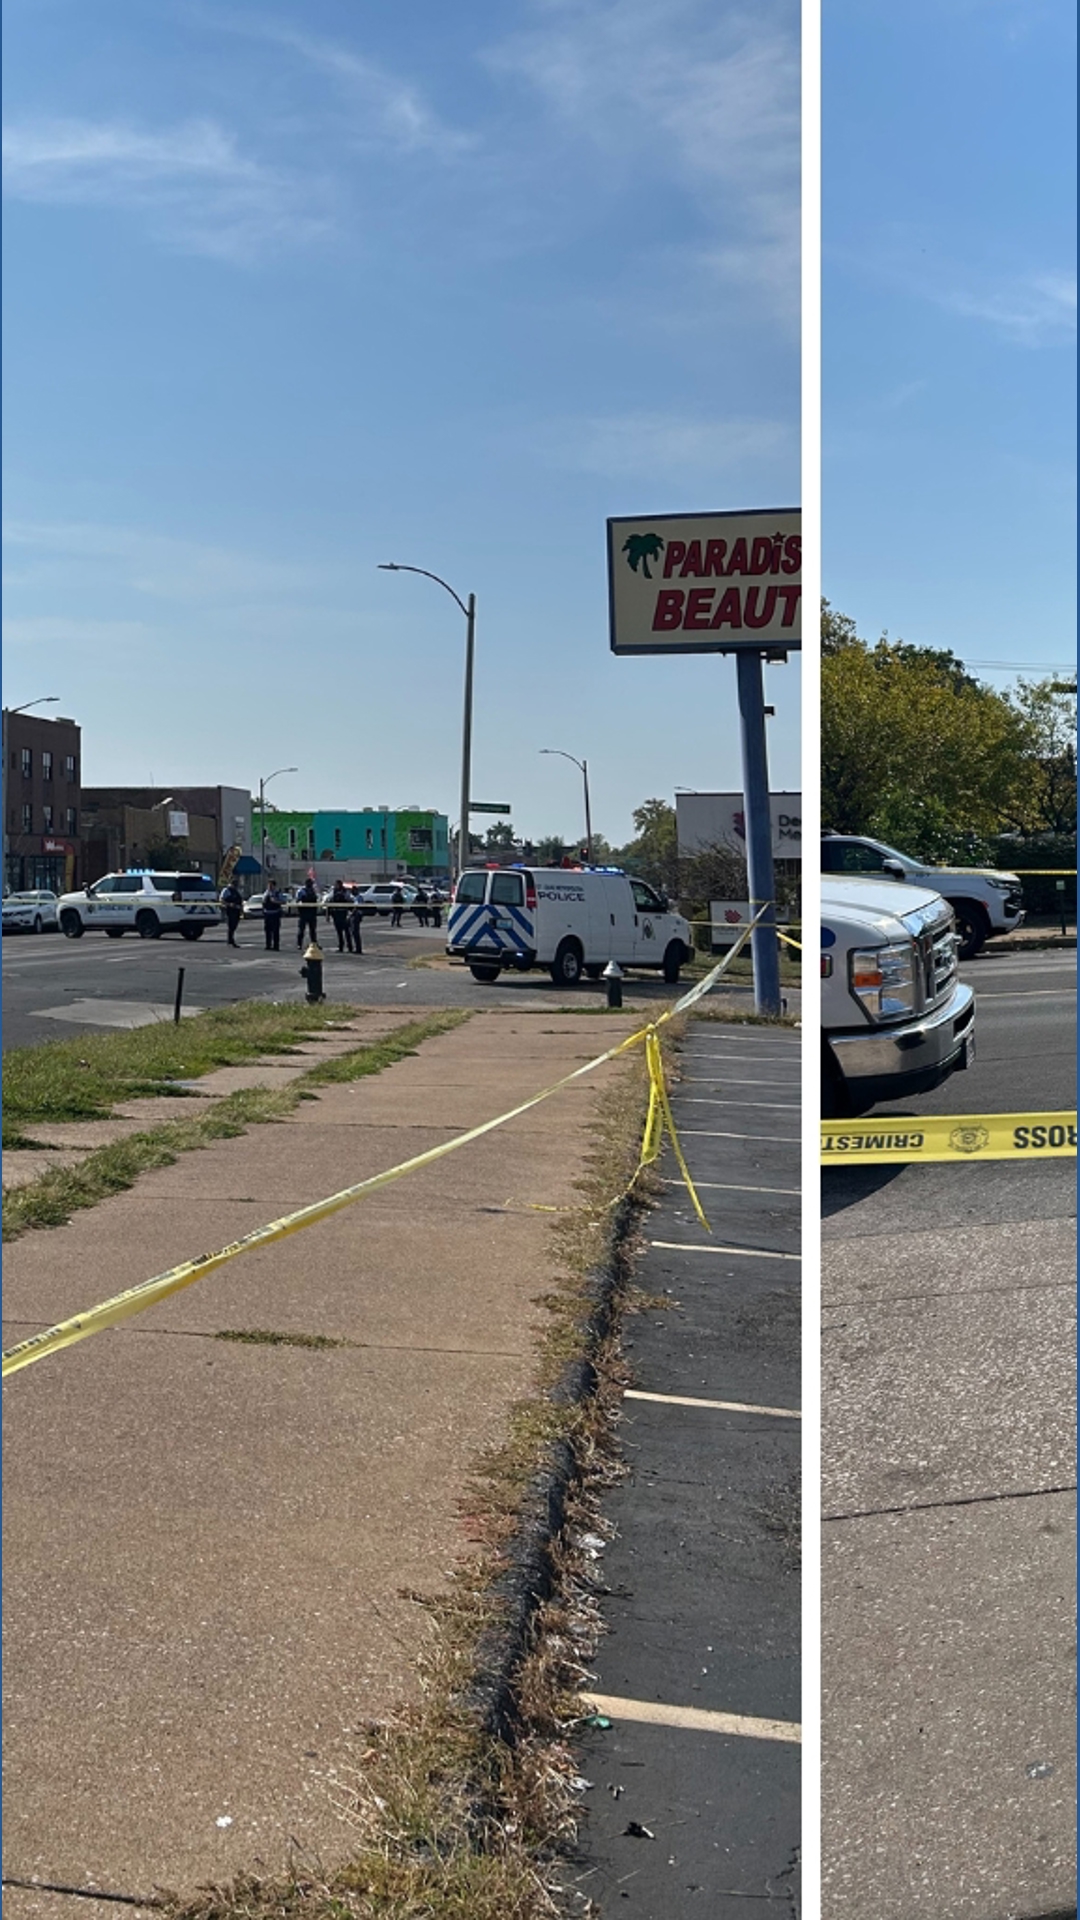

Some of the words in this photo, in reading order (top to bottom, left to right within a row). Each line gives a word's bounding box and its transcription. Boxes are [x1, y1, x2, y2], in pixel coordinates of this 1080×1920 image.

[652, 584, 801, 631] BEAUT
[778, 814, 801, 827] De
[537, 891, 586, 902] POLICE
[820, 1132, 924, 1151] CRIMEST
